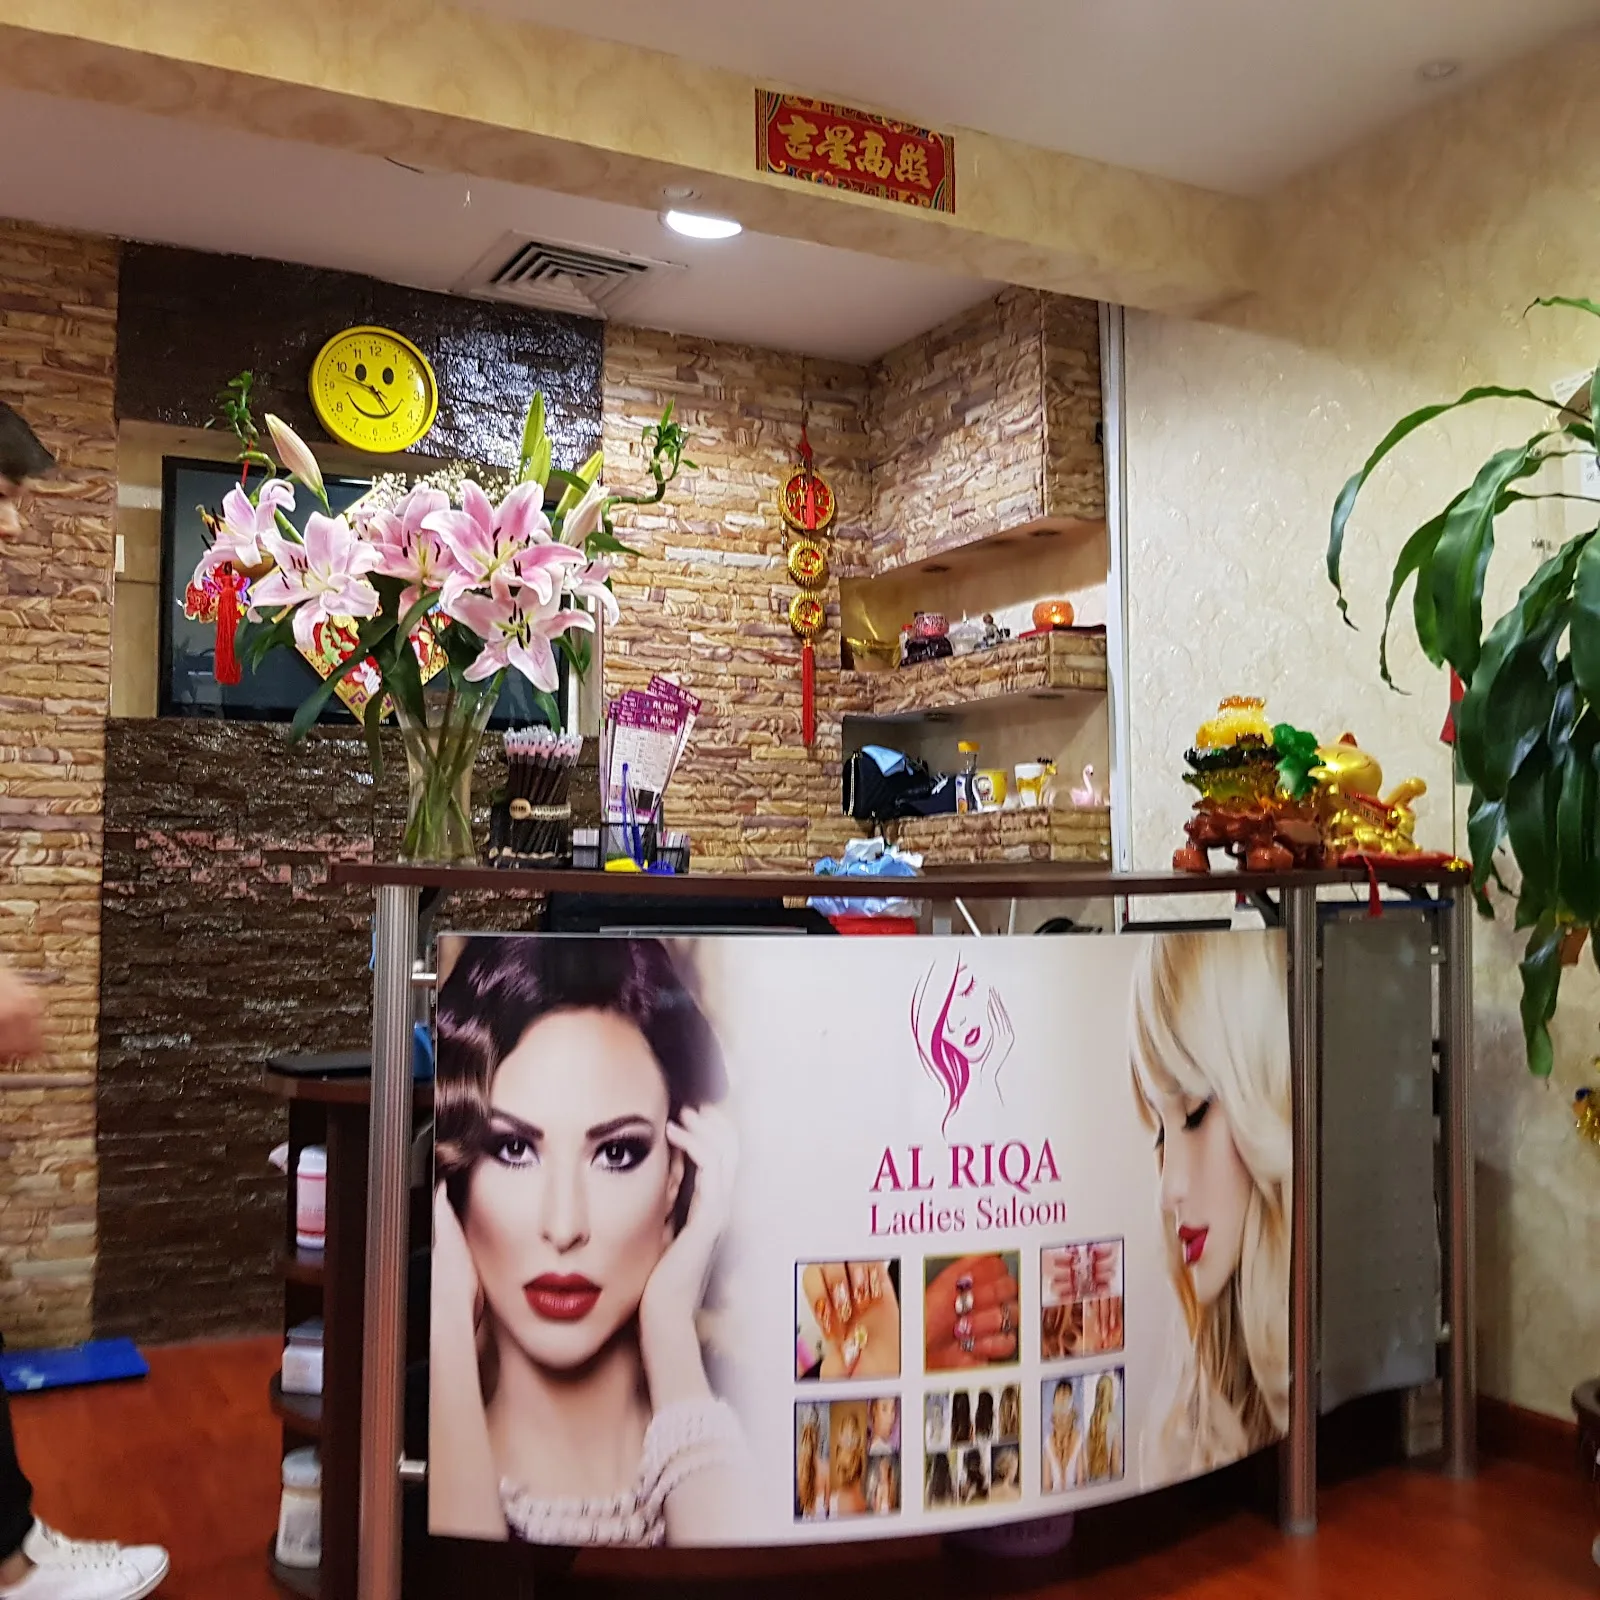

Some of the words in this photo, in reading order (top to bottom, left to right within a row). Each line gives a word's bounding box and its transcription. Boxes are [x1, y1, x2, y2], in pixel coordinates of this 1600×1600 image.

[353, 348, 362, 360] 11
[369, 345, 382, 357] 12
[336, 361, 348, 373] 10
[407, 368, 414, 380] 2
[329, 381, 335, 391] 9
[413, 391, 420, 401] 3
[336, 401, 344, 413] 8
[407, 409, 413, 420] 4
[352, 417, 359, 428] 7
[391, 421, 399, 433] 5
[372, 425, 378, 436] 6
[652, 700, 661, 710] AL
[649, 714, 659, 724] AL
[868, 1145, 935, 1193] AL
[947, 1137, 1062, 1195] RIQA
[868, 1197, 965, 1237] Ladies
[976, 1193, 1067, 1231] Saloon
